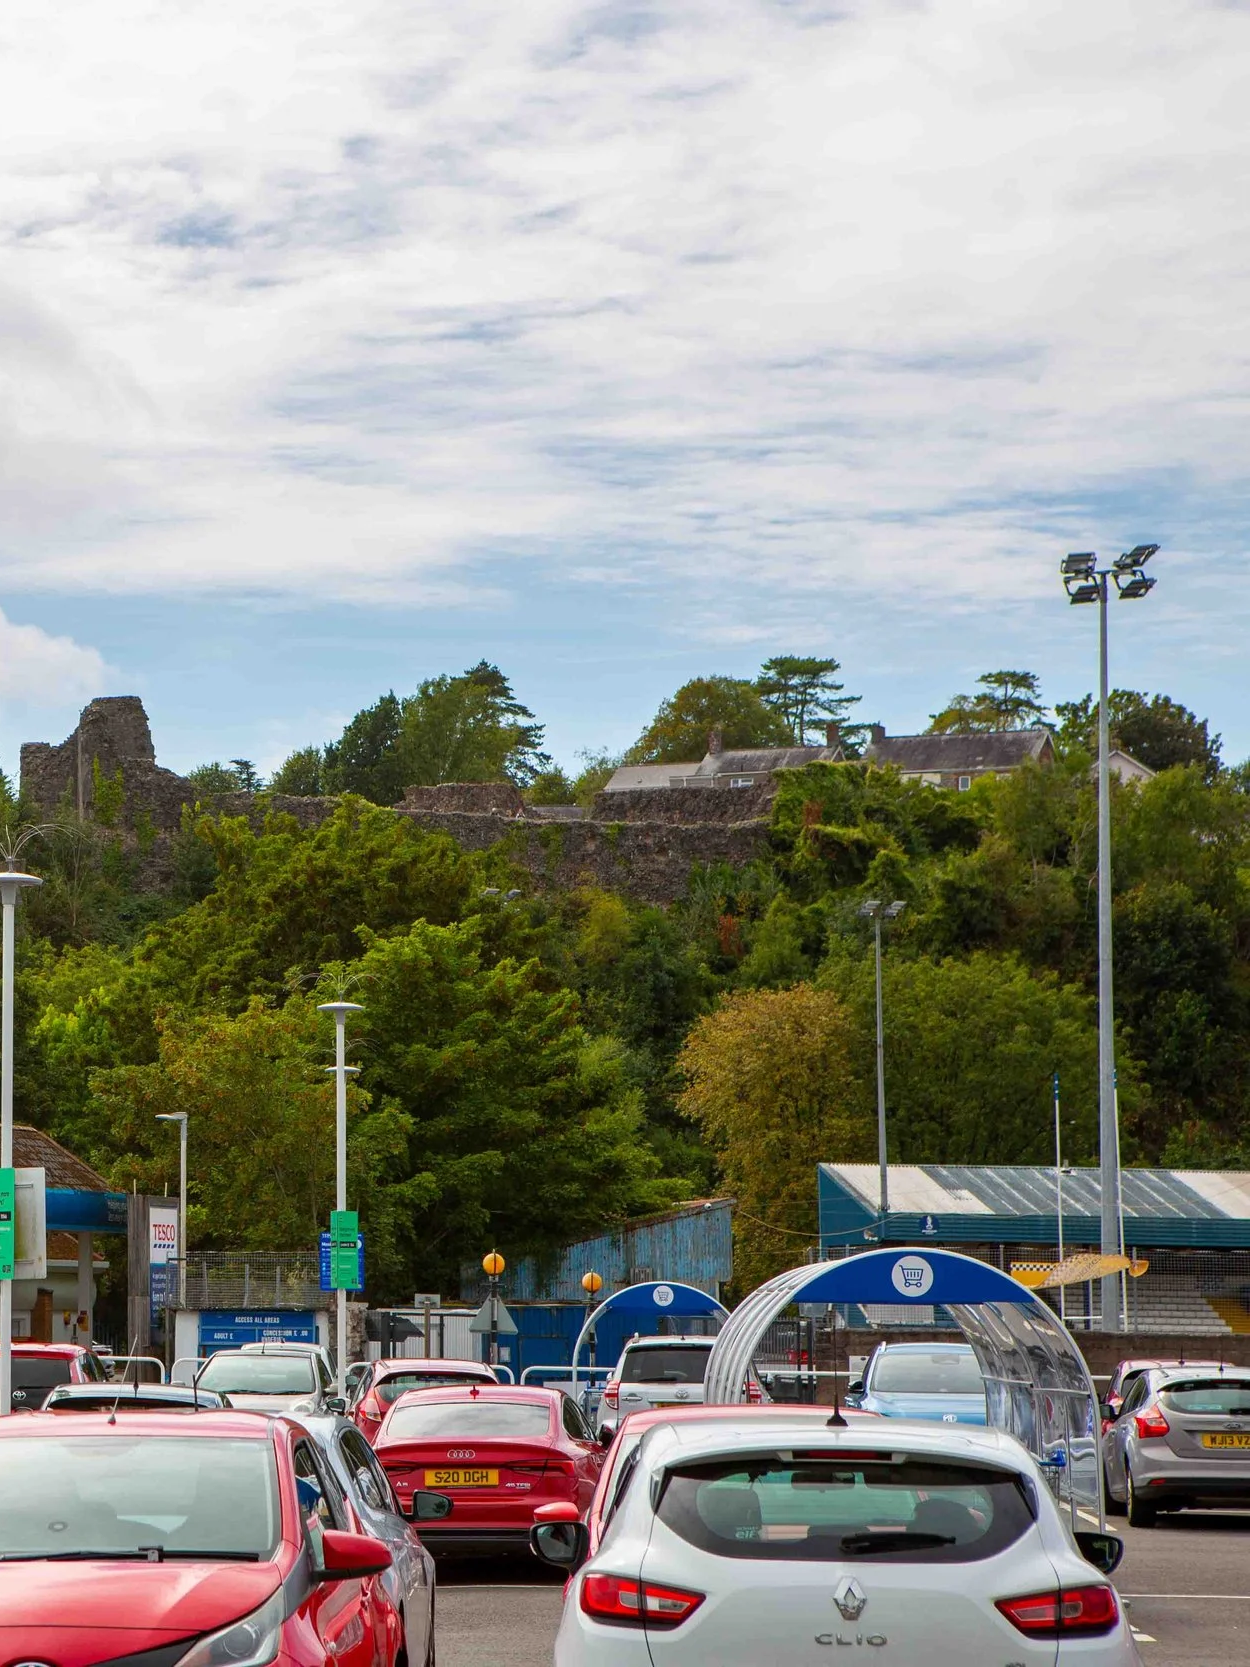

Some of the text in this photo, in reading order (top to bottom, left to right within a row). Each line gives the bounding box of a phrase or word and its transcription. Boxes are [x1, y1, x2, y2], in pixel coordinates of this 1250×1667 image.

[153, 1224, 175, 1241] TESCO
[213, 1332, 228, 1340] ADULT
[434, 1471, 489, 1484] S20 DGH
[814, 1633, 888, 1647] CLIO
